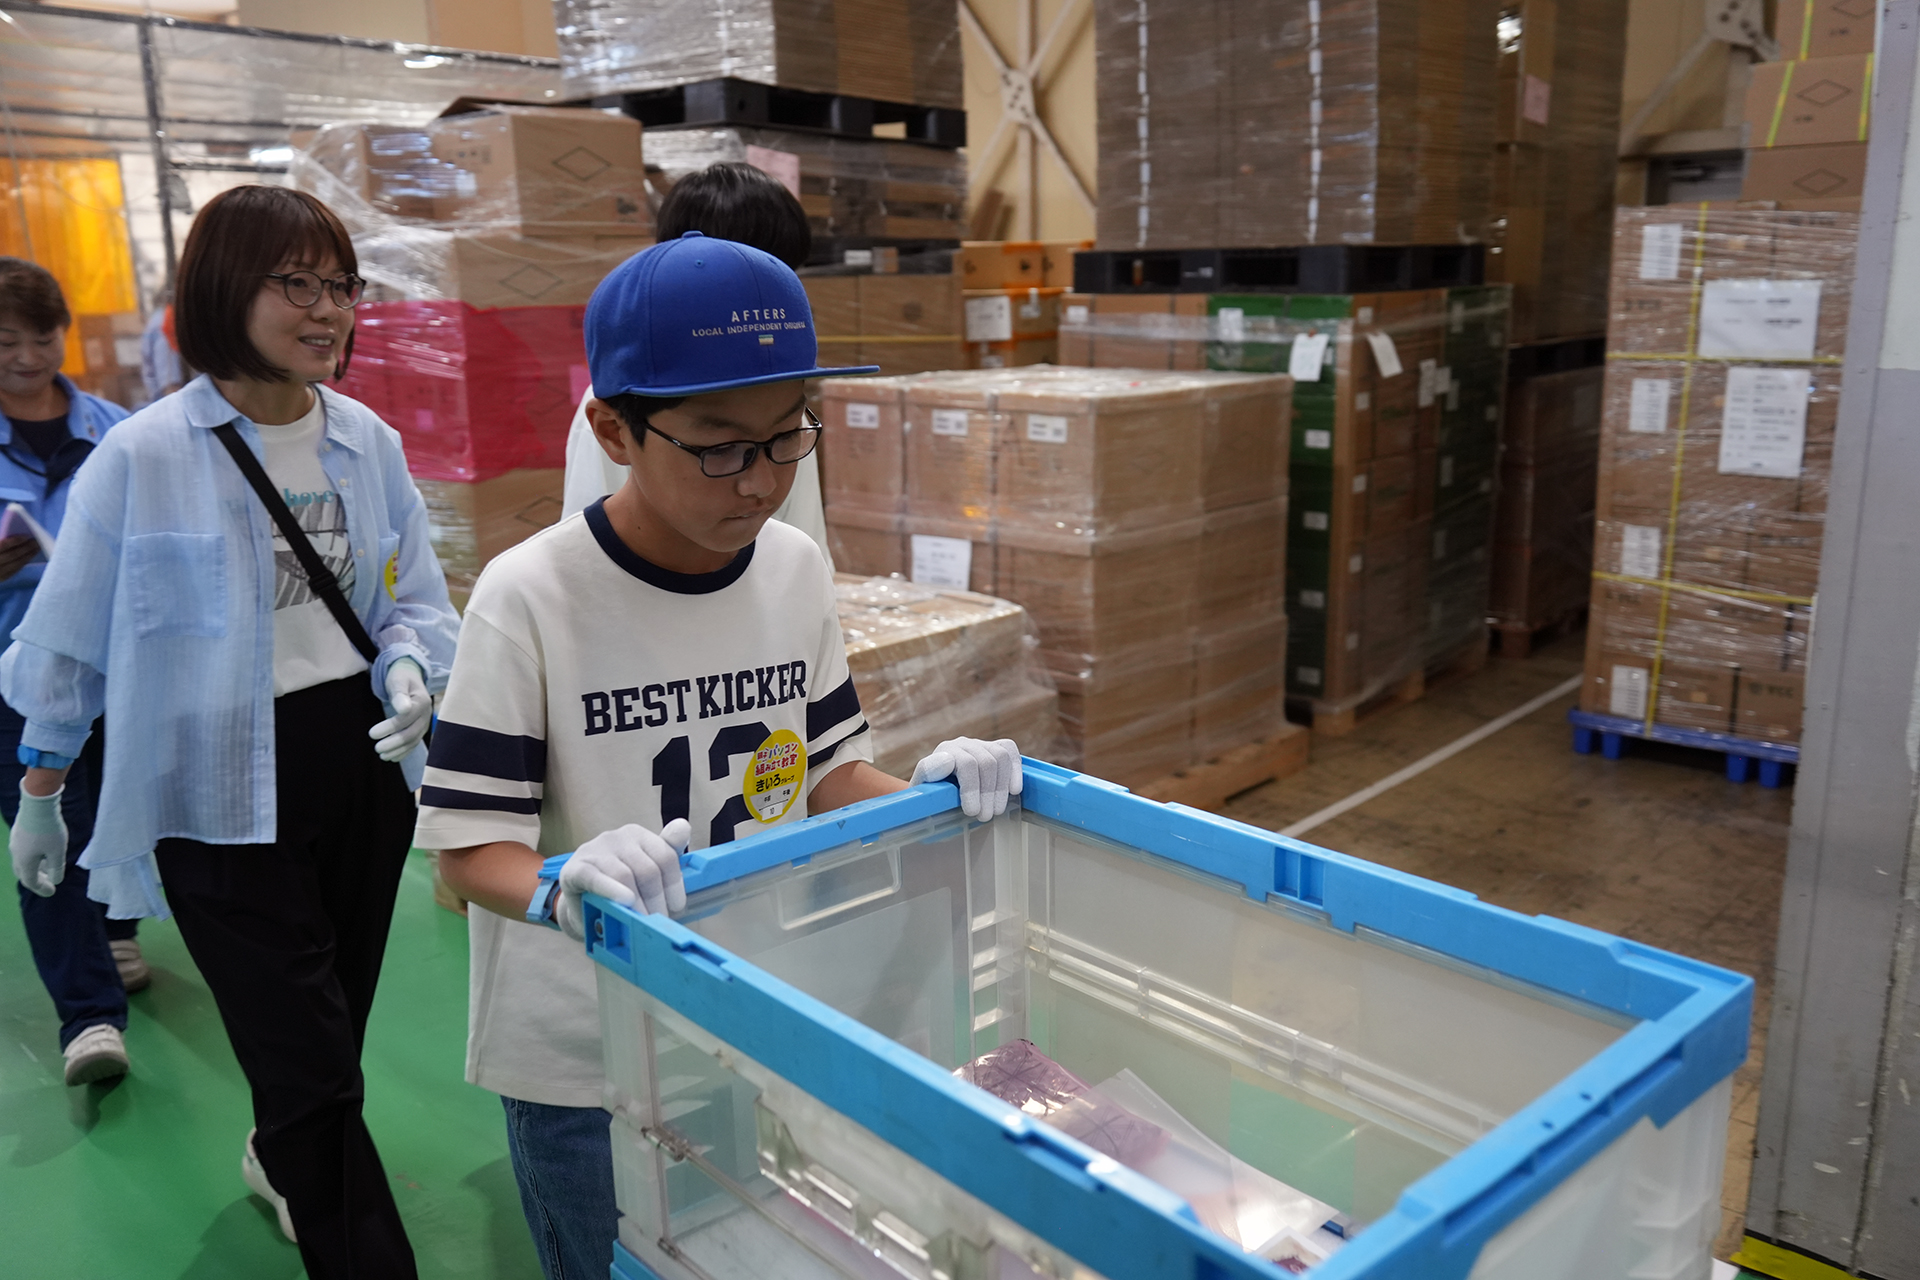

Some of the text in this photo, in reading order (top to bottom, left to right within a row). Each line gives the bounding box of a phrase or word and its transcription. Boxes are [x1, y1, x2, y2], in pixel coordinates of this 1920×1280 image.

[731, 308, 786, 322] AFTERS
[692, 327, 724, 337] LOCAL
[727, 322, 782, 334] INDEPENDENT
[581, 660, 806, 736] BEST KICKER
[755, 753, 798, 777] 組み立て教室
[652, 721, 772, 853] 12
